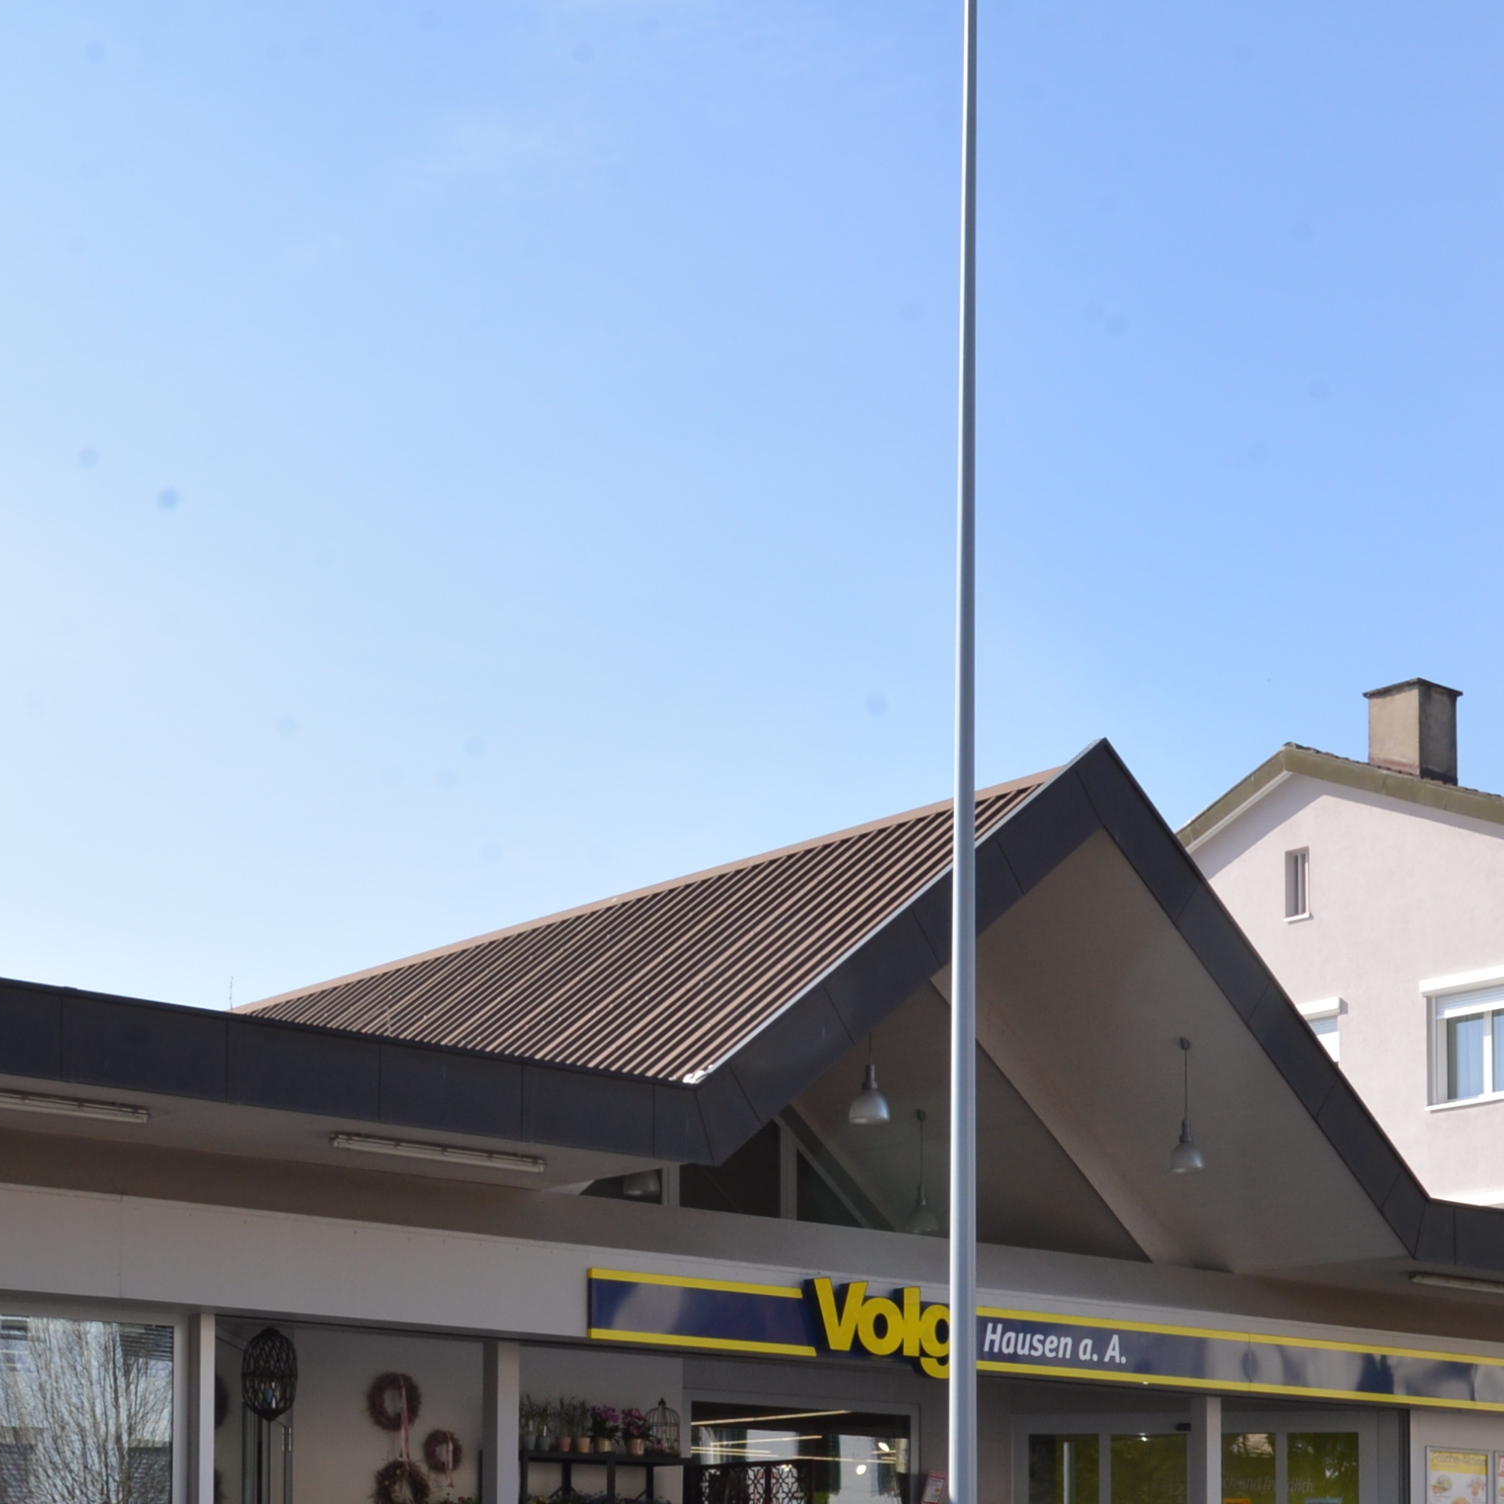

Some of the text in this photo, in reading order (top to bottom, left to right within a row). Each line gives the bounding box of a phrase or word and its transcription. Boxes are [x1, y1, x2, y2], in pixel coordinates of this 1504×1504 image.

[808, 1276, 950, 1380] Volg
[983, 1322, 1127, 1364] Hausen a. A.
